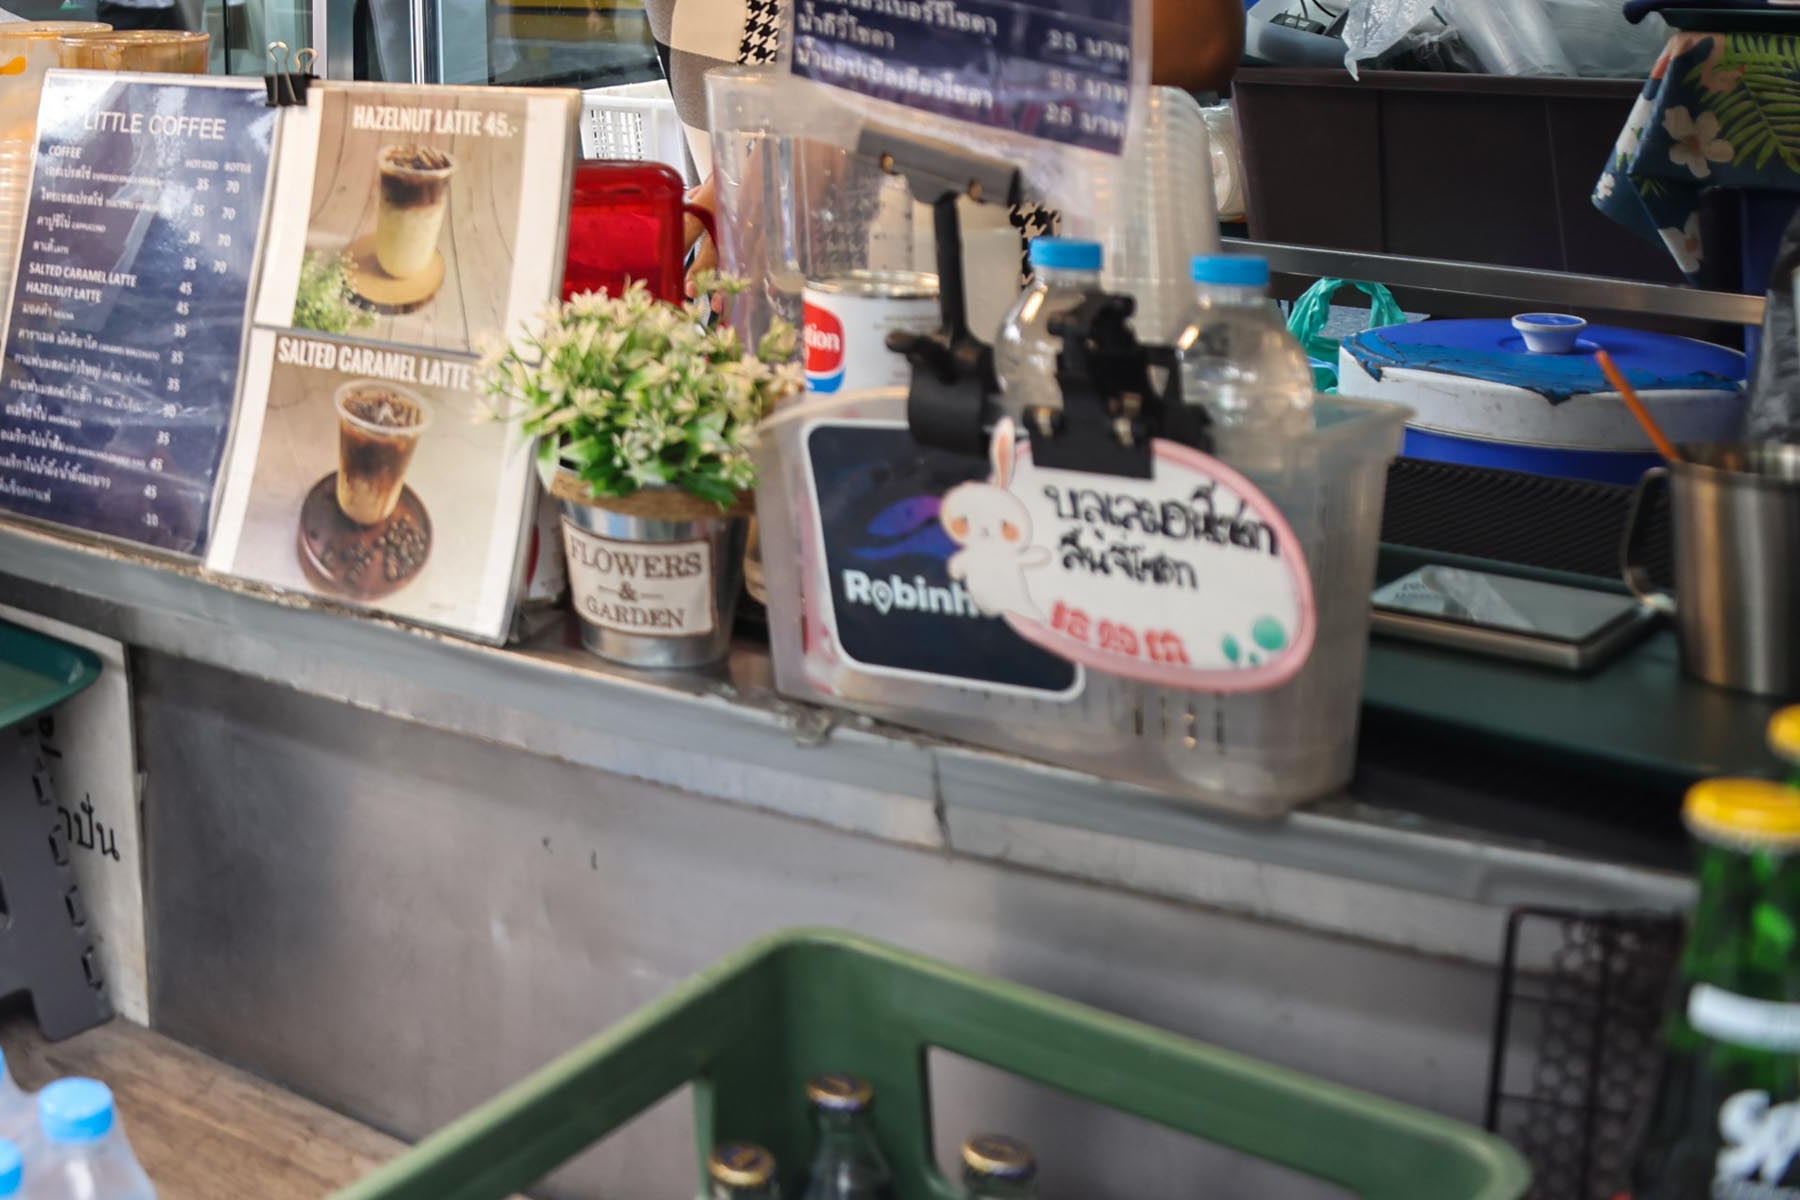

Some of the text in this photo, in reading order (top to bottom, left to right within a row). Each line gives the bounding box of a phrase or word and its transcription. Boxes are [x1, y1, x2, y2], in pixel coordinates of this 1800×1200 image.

[84, 112, 227, 140] LITTLE COFFEE
[353, 105, 519, 138] HAZELNUT LATTE 45.-
[49, 144, 82, 160] COFFEE
[29, 262, 63, 278] SALTED
[63, 265, 107, 284] CARAMEL
[108, 271, 138, 288] LATTE
[26, 281, 73, 298] HAZELNUT
[74, 287, 102, 304] LATTE
[277, 337, 336, 370] SALTED
[338, 345, 418, 383] CARAMEL
[421, 359, 473, 392] LATTE
[570, 536, 703, 579] FLOWERS
[618, 580, 637, 602] &
[586, 595, 686, 628] GARDEN
